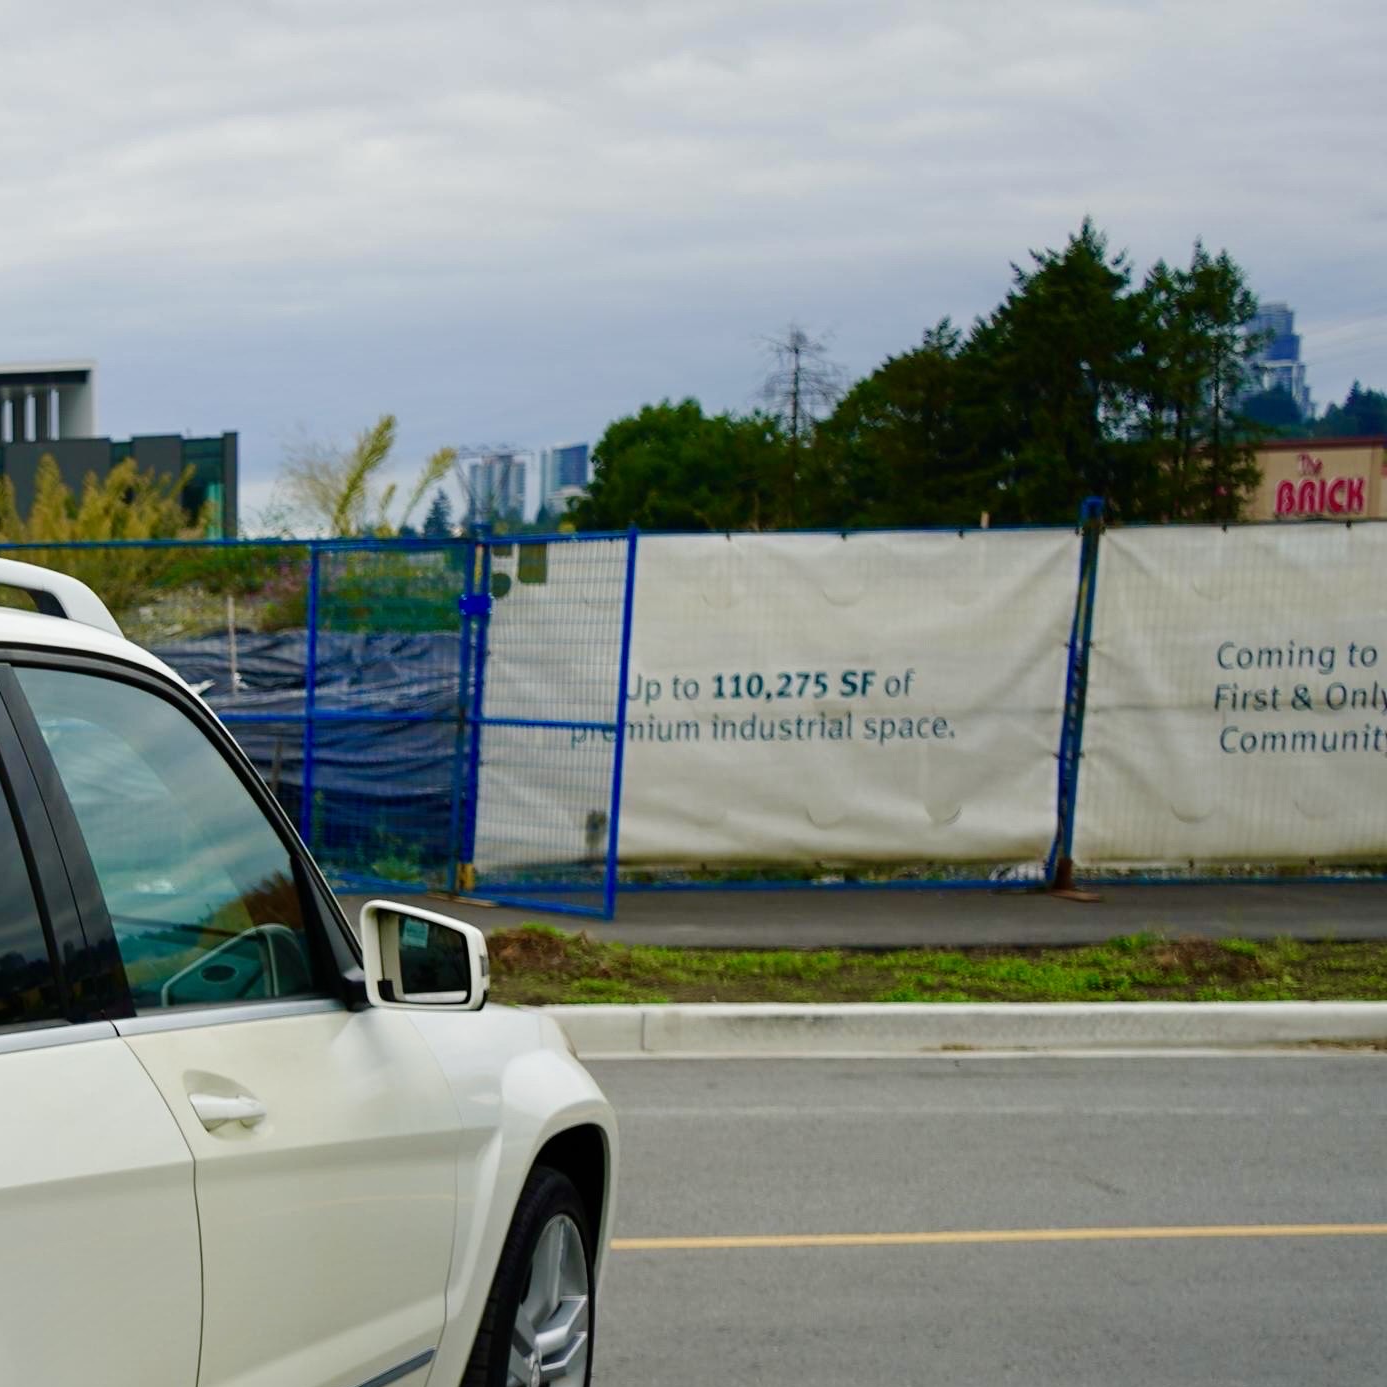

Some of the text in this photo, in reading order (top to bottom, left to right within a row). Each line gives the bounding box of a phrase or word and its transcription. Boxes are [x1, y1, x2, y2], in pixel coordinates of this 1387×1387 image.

[1275, 476, 1365, 517] BRICK
[1217, 639, 1378, 675] Coming to
[673, 675, 700, 699] to
[713, 672, 829, 700] 110,275
[839, 669, 877, 698] SF
[884, 667, 916, 697] of
[1214, 681, 1281, 712] First
[1290, 683, 1314, 712] &
[711, 711, 854, 742] industrial
[863, 715, 956, 745] space.
[1220, 723, 1387, 758] Communit
